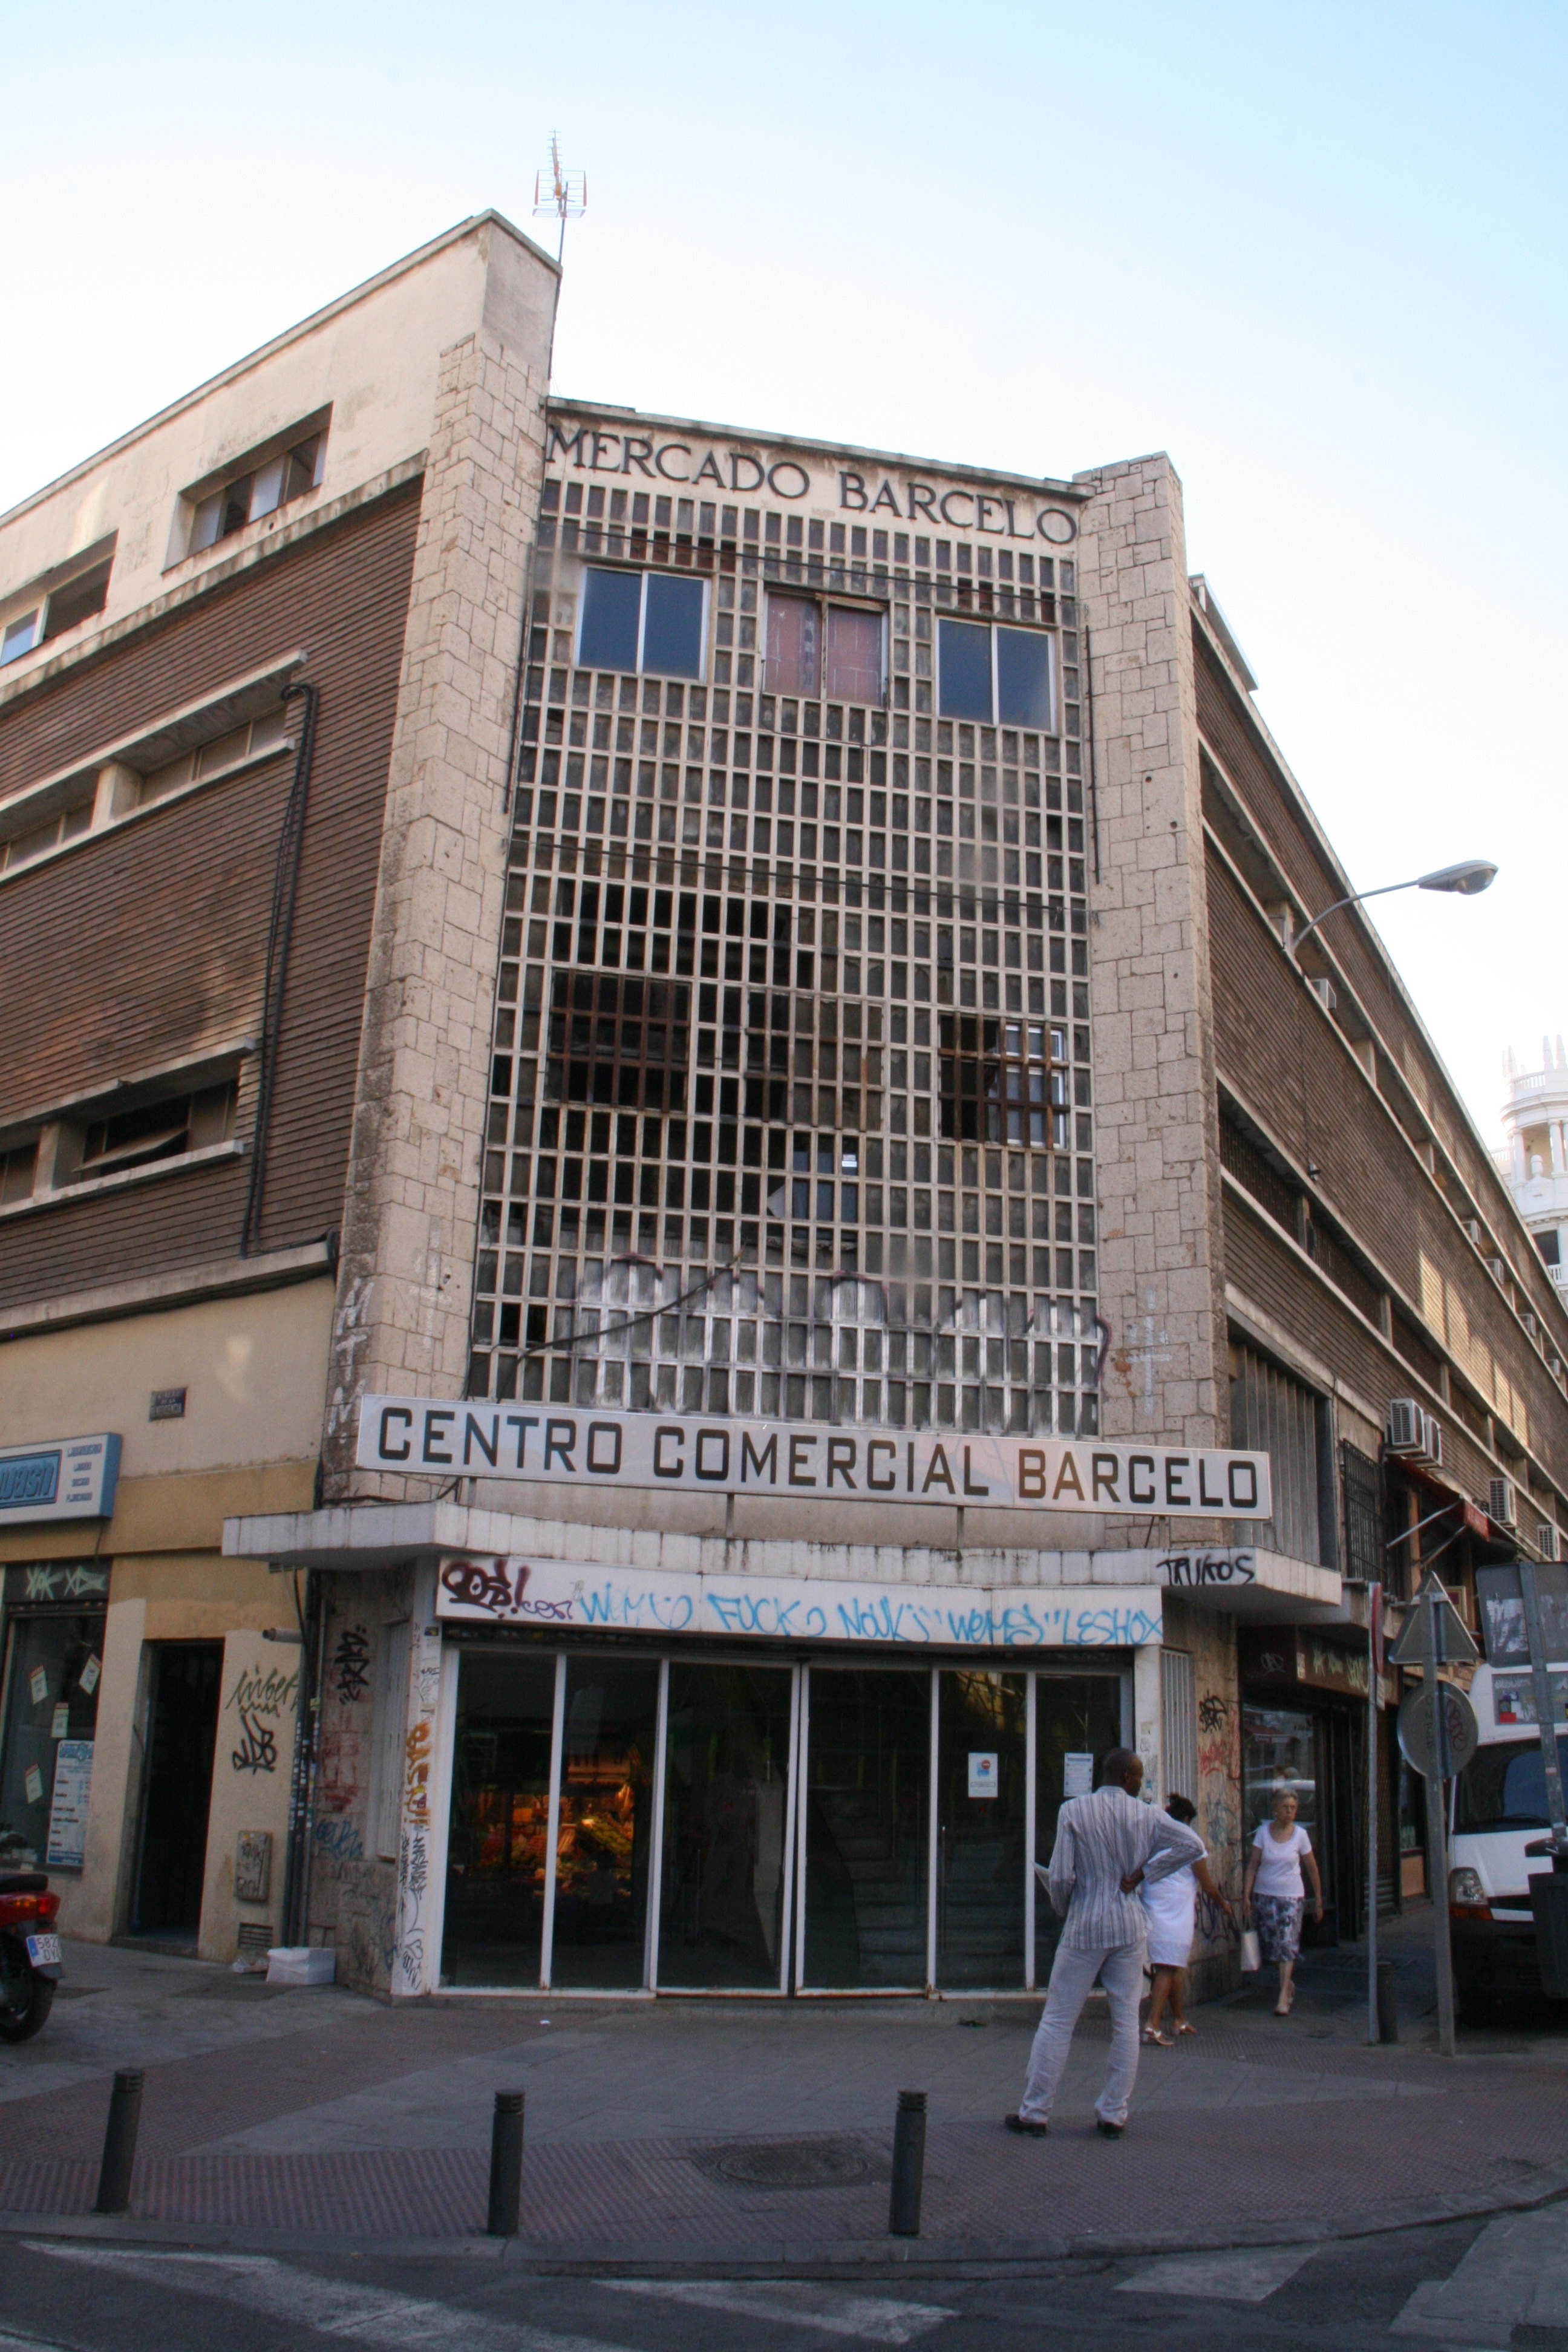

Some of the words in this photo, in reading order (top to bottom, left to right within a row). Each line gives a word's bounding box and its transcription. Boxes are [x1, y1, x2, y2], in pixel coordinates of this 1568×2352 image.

[545, 423, 810, 498] MERCADO
[838, 471, 1077, 544] BARCELO
[378, 1406, 622, 1474] CENTRO
[653, 1425, 989, 1497] COMERCIAL
[1019, 1448, 1258, 1508] BARCELO
[707, 1593, 800, 1637] FUCK
